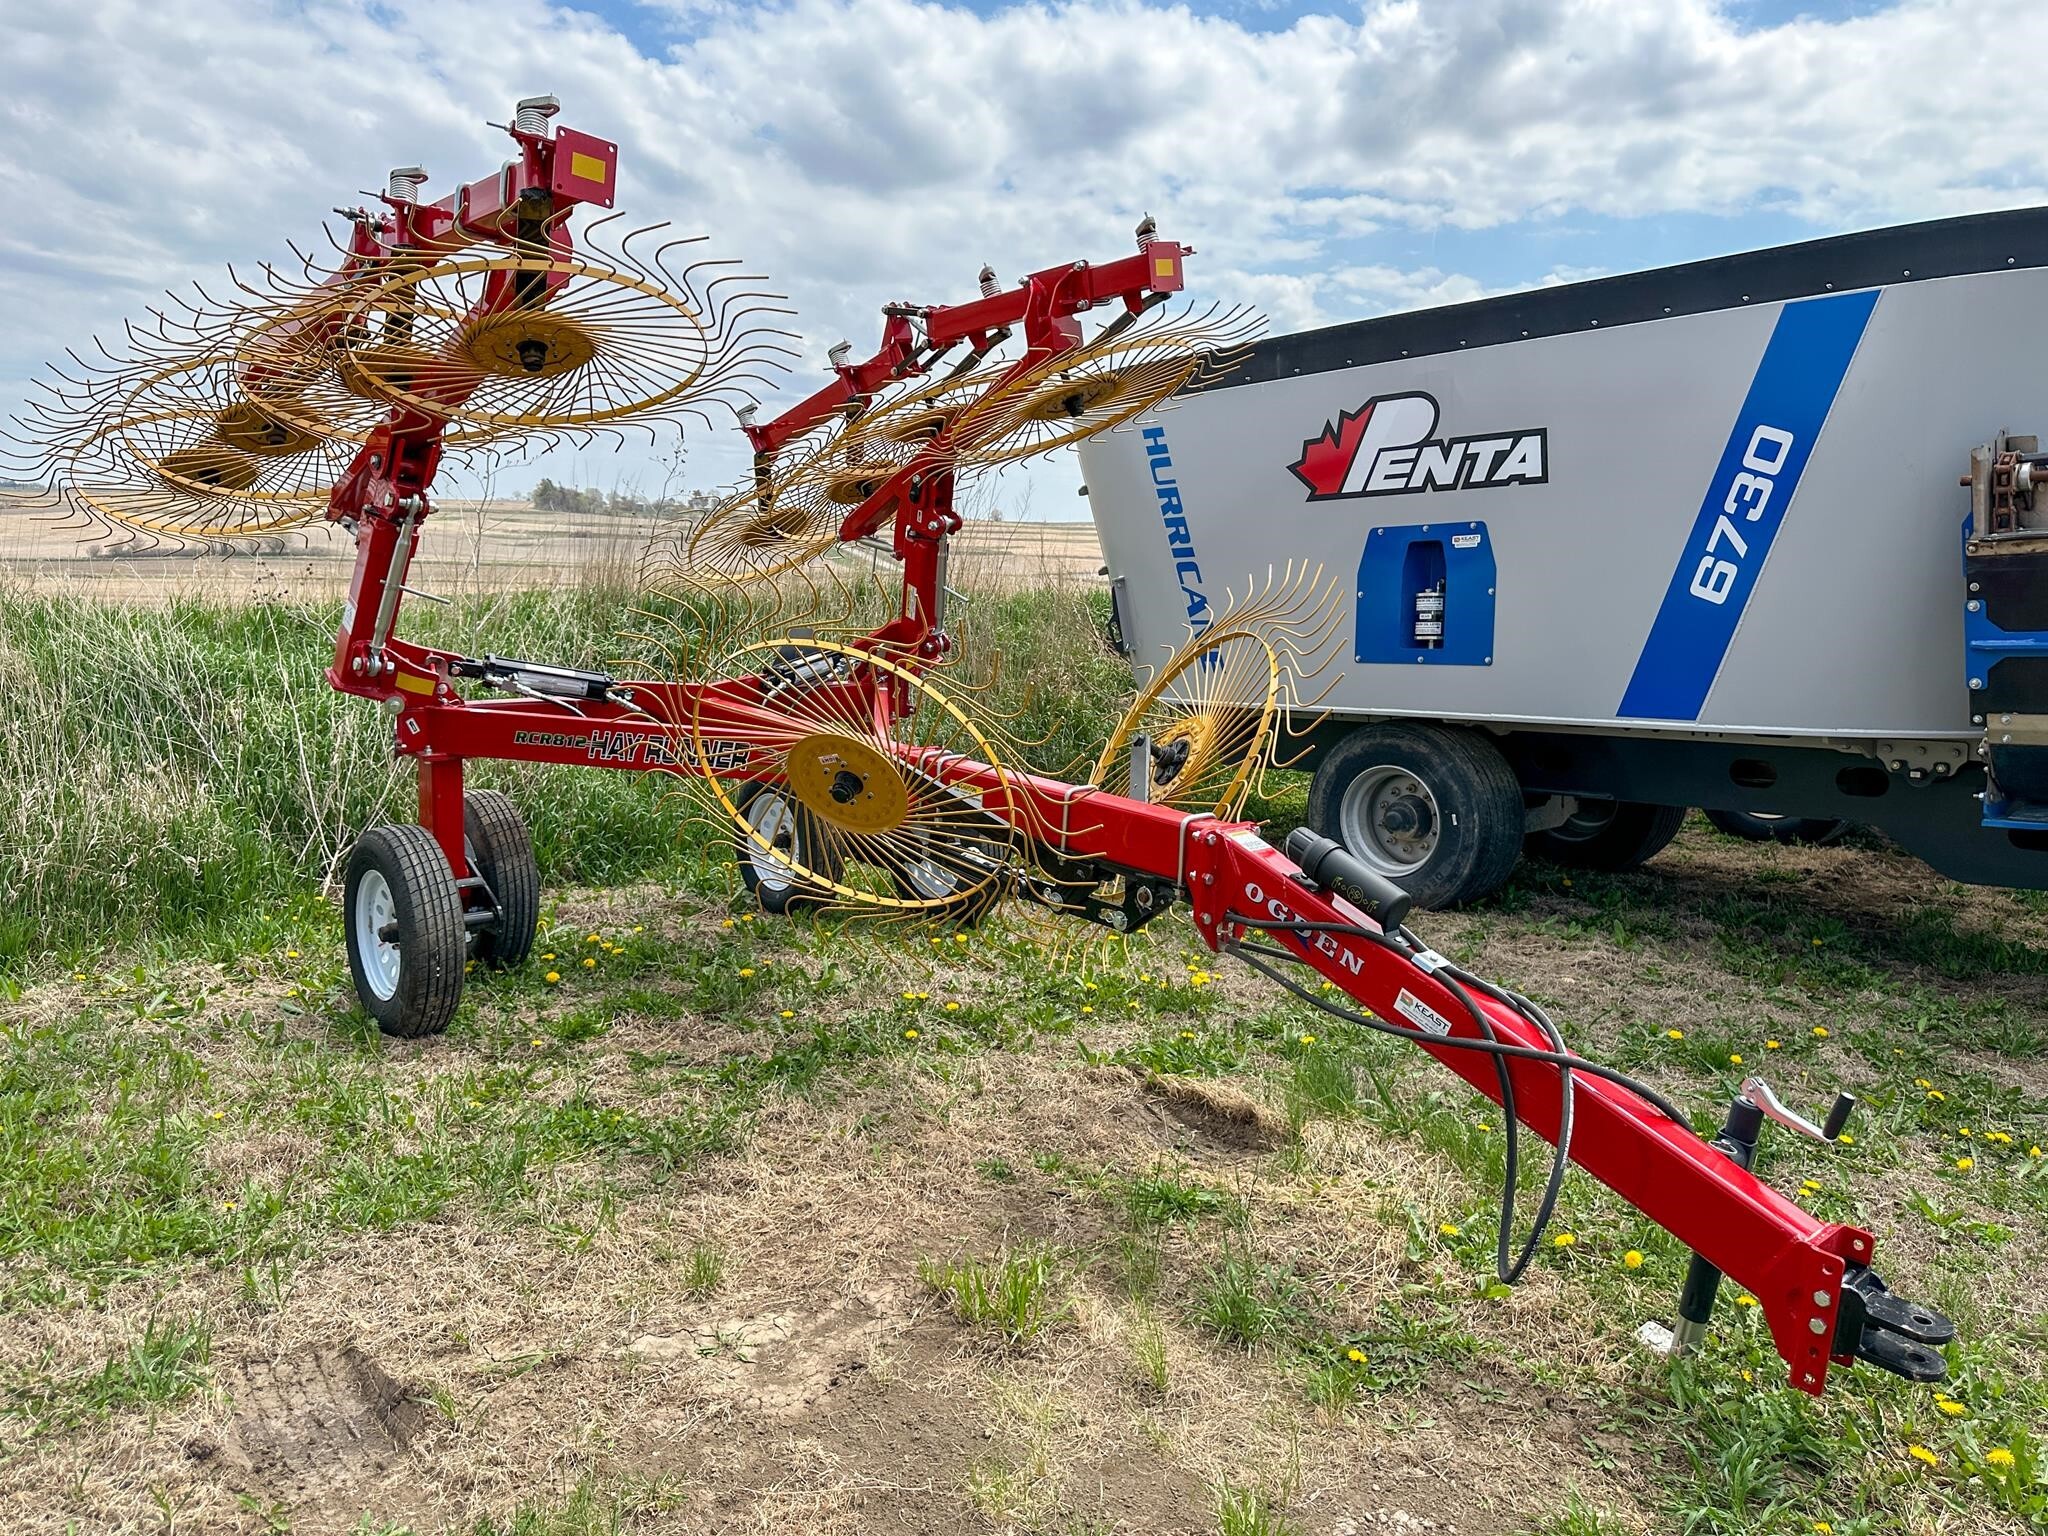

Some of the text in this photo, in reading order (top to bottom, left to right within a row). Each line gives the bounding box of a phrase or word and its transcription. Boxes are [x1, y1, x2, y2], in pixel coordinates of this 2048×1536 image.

[1341, 397, 1543, 494] PENTA
[1690, 424, 1794, 605] 6730
[514, 731, 587, 748] RCR812
[588, 730, 645, 761] HAY
[1245, 883, 1365, 975] OGDEN
[1414, 1002, 1449, 1030] KEAST
